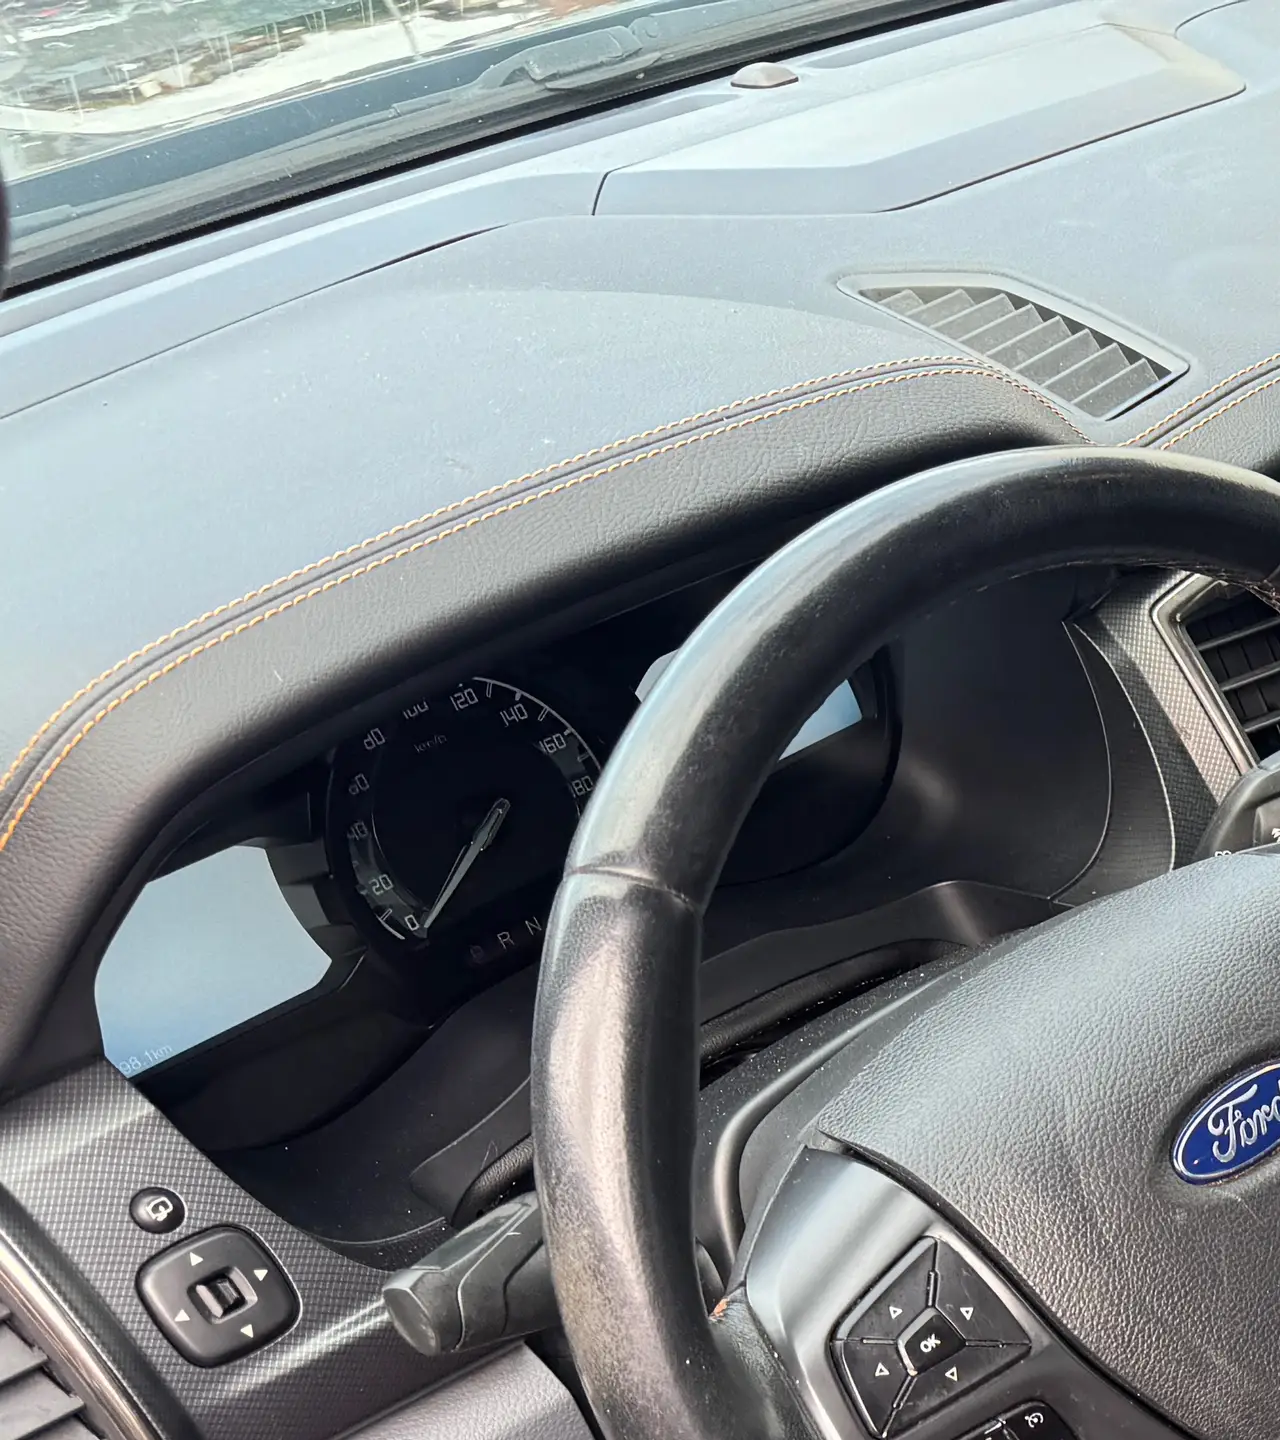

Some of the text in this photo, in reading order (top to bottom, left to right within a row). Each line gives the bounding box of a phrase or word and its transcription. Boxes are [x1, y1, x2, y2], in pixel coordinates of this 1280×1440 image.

[450, 688, 478, 711] 120
[500, 703, 528, 727] 140
[539, 733, 566, 754] 160
[369, 874, 394, 895] 20
[404, 914, 420, 931] 0
[497, 916, 543, 950] R N
[920, 1334, 941, 1353] OK
